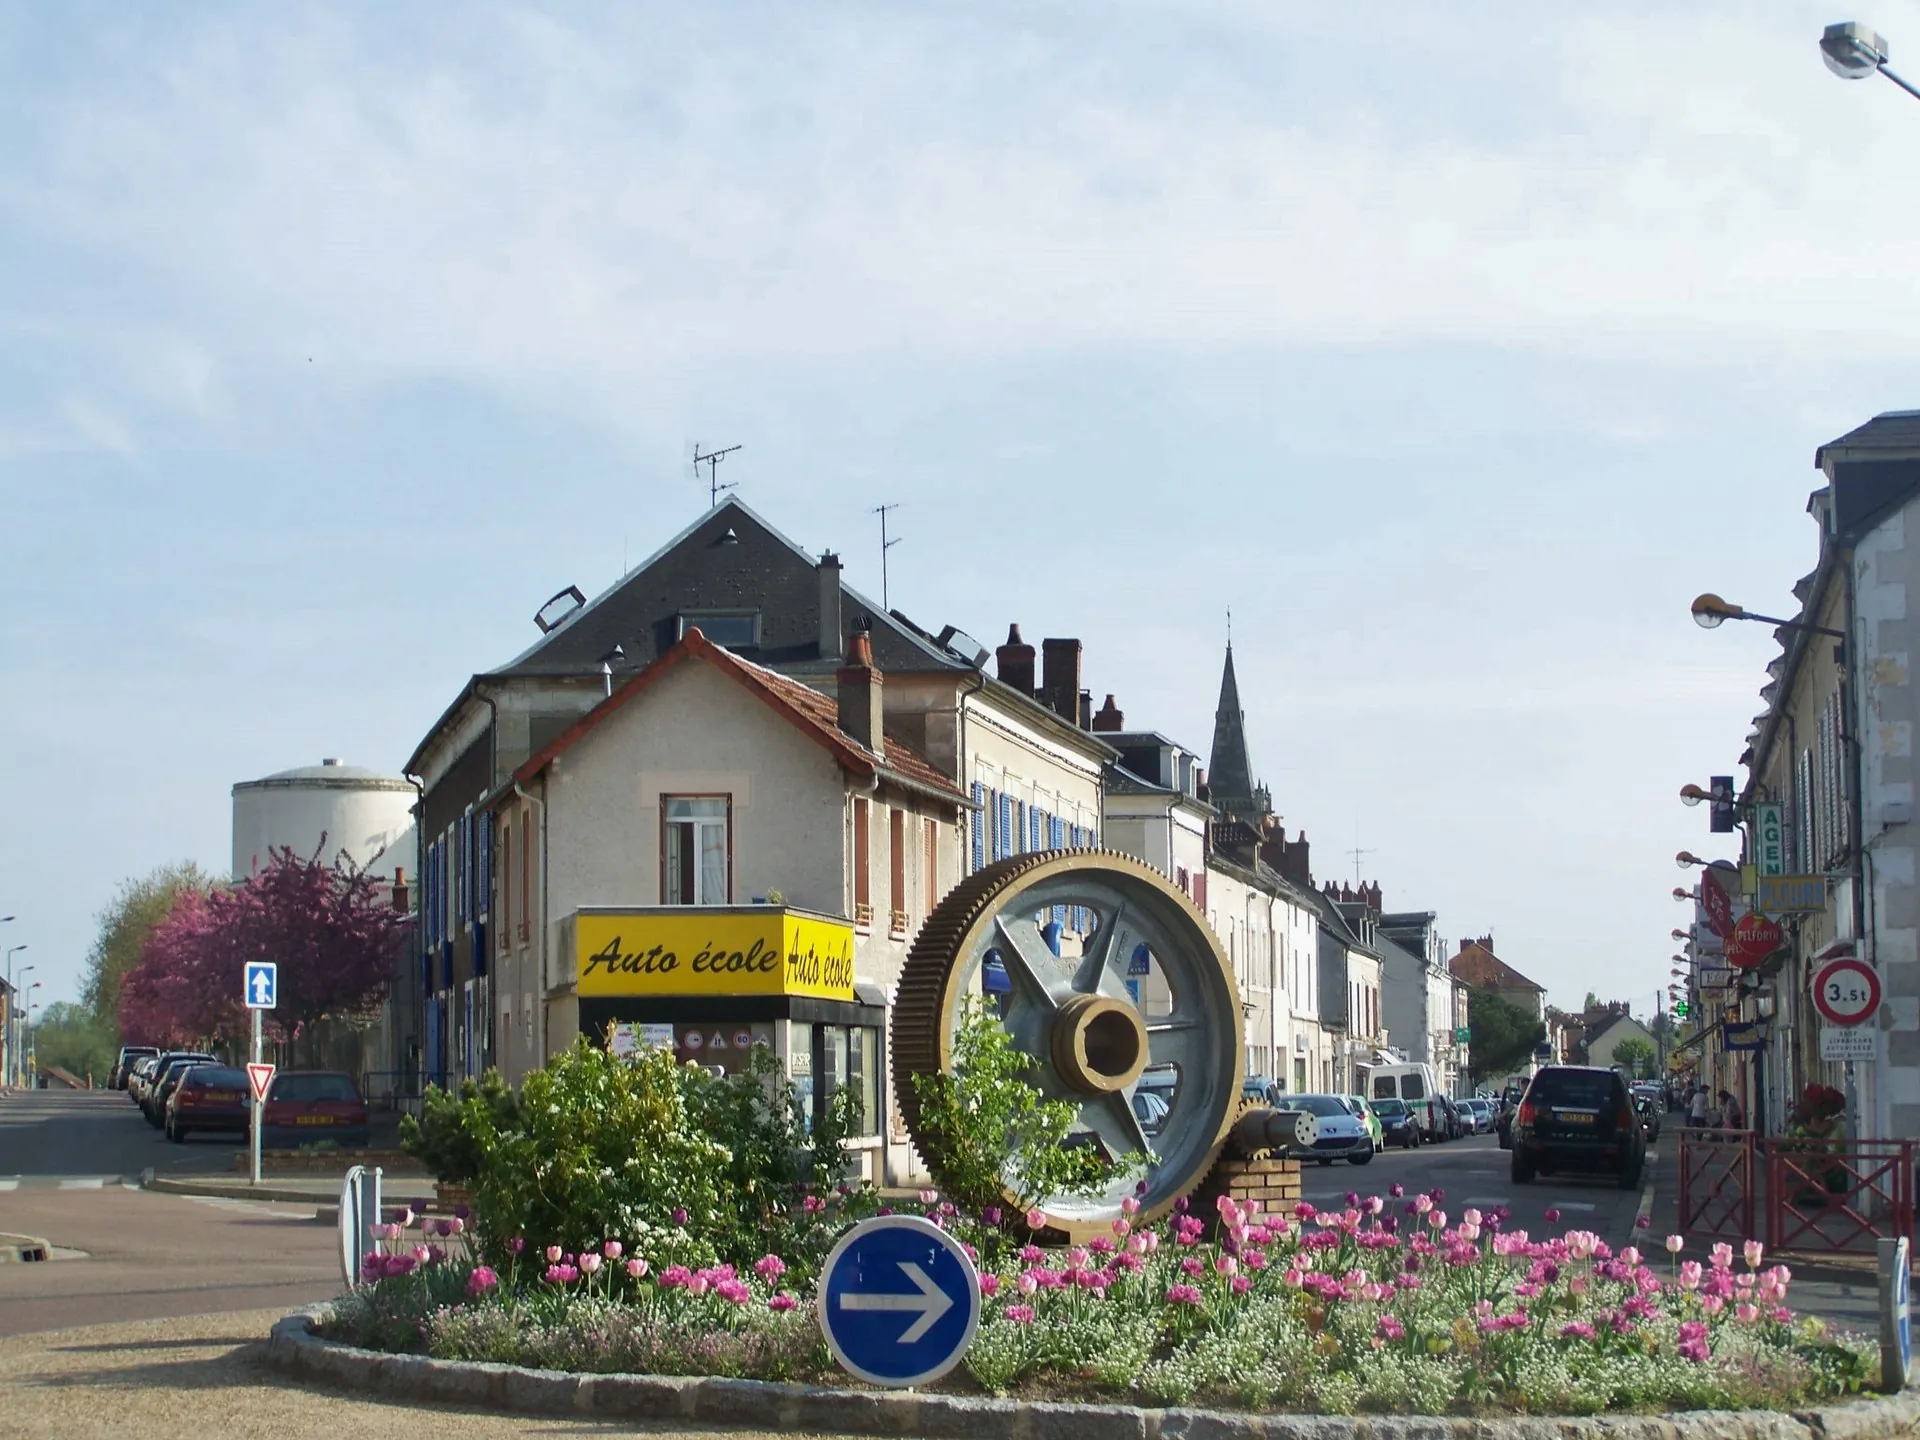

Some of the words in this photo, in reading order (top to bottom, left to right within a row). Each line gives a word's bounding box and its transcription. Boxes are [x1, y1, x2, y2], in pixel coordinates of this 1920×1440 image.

[1738, 929, 1780, 942] PELFORTH
[583, 936, 681, 976] Auto
[692, 937, 779, 973] école
[786, 926, 819, 985] Auto
[824, 938, 852, 988] école
